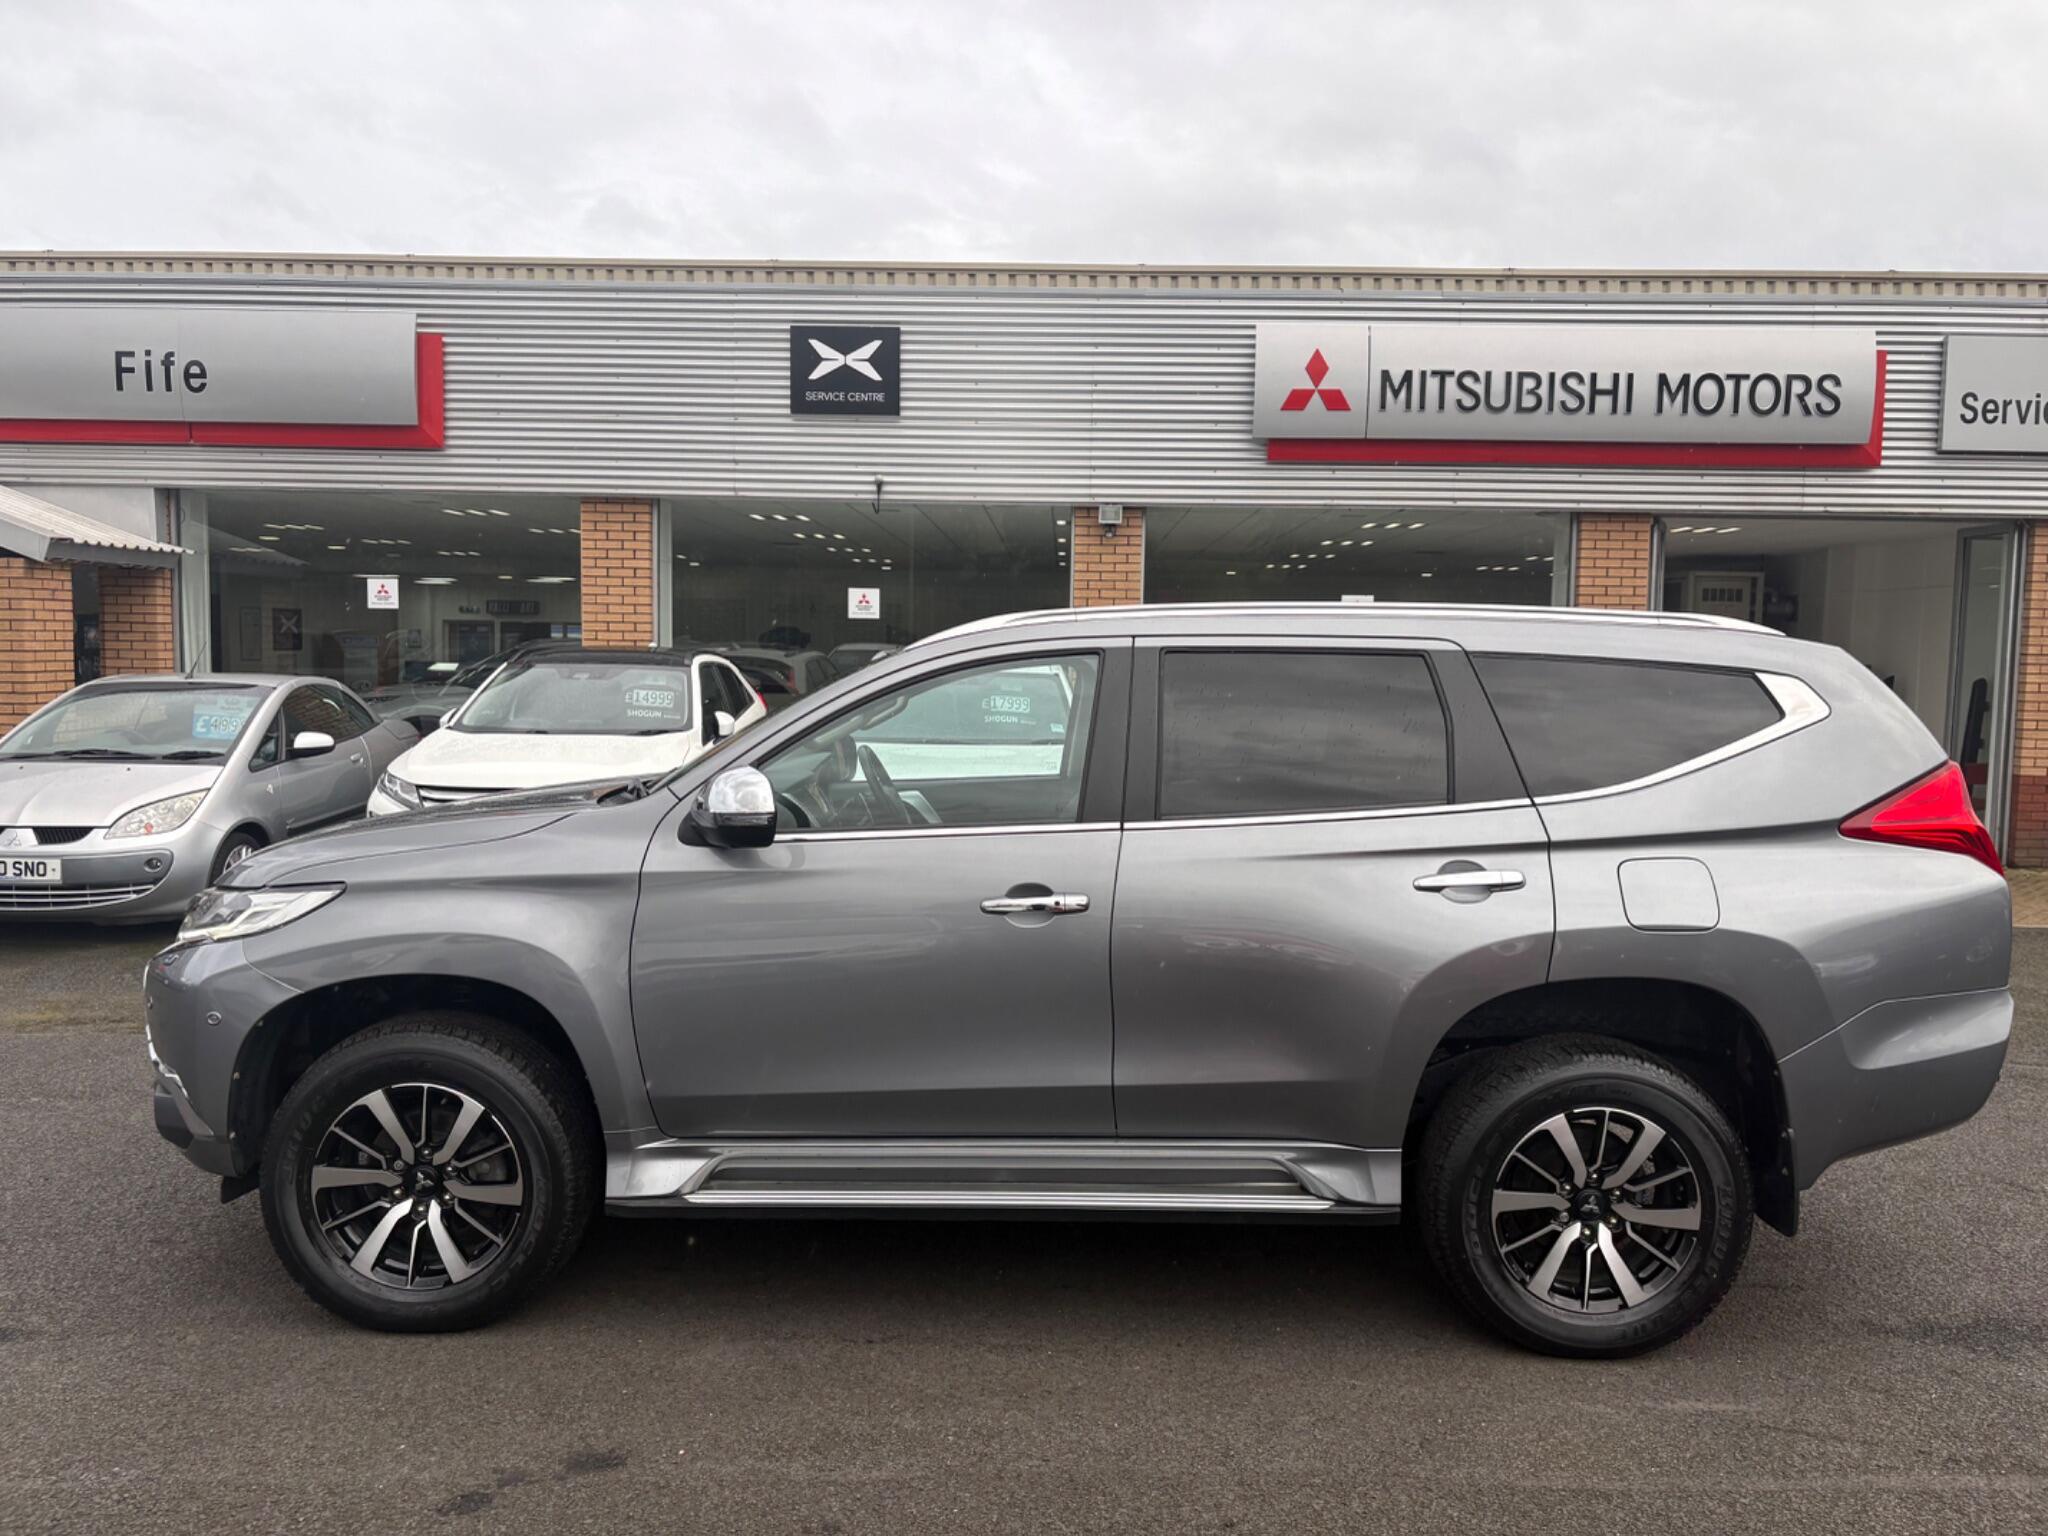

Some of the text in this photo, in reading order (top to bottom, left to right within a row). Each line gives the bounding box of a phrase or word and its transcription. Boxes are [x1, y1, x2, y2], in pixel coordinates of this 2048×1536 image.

[114, 349, 208, 393] Fife
[805, 391, 885, 402] SERVICE CENTRE
[1378, 369, 1843, 417] MITSUBISHI MOTORS
[626, 709, 662, 718] SHOGUN
[984, 715, 1019, 724] SHOGUN
[12, 860, 47, 877] SNO
